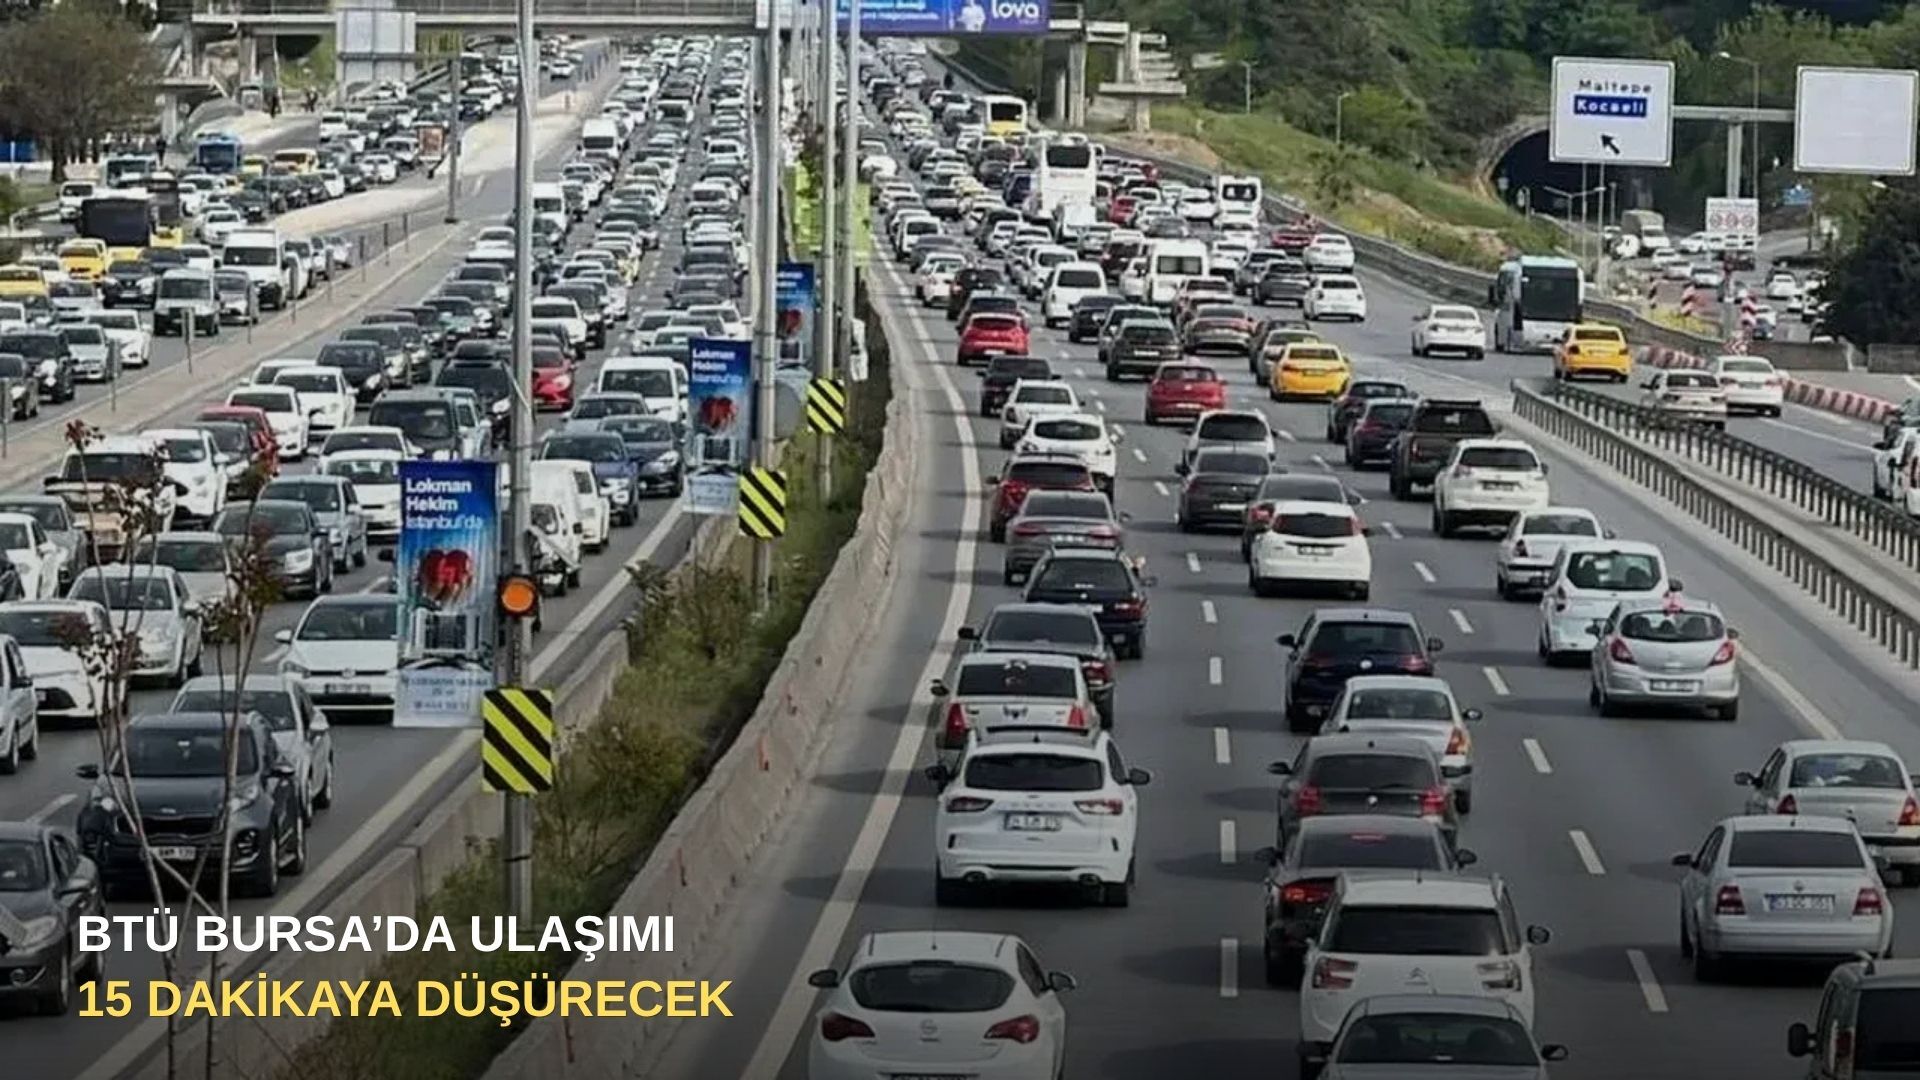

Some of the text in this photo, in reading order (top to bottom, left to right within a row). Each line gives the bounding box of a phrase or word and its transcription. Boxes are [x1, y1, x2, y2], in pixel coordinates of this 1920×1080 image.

[991, 0, 1040, 19] lova
[1579, 79, 1652, 94] Maltepe
[1576, 99, 1644, 114] Kocaeli
[406, 477, 472, 493] Lokman
[406, 496, 459, 511] Hekim
